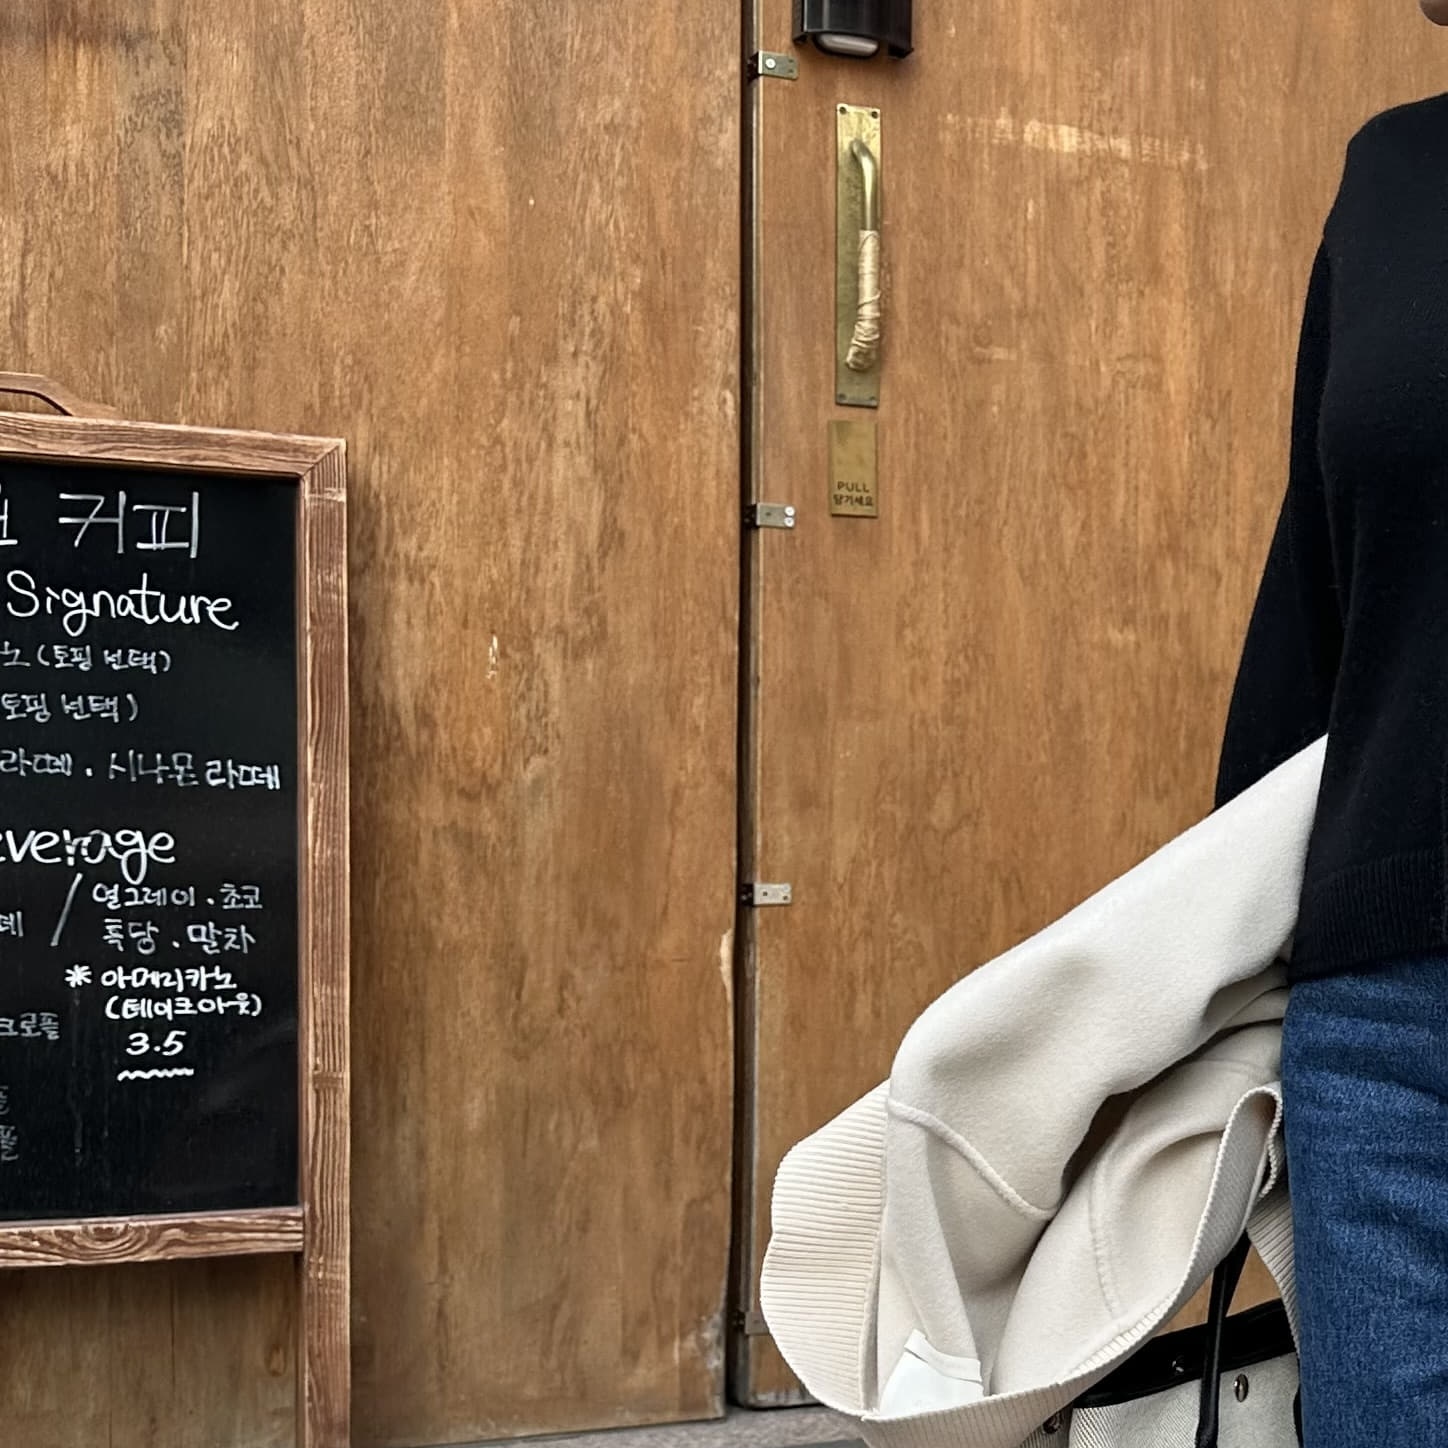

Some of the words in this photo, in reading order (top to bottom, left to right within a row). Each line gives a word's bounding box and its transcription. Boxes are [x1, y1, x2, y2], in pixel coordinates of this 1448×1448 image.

[833, 494, 873, 506] 당기세요
[837, 481, 870, 493] PULL
[59, 490, 199, 558] 커피
[6, 570, 240, 637] Signature
[108, 750, 199, 787] 시나몬
[0, 829, 176, 885] verage
[219, 883, 263, 910] 초코
[186, 920, 256, 954] 말차
[101, 965, 237, 993] 아메리카노
[105, 992, 262, 1021] (테이크아웃)
[126, 1031, 187, 1056] 3.5
